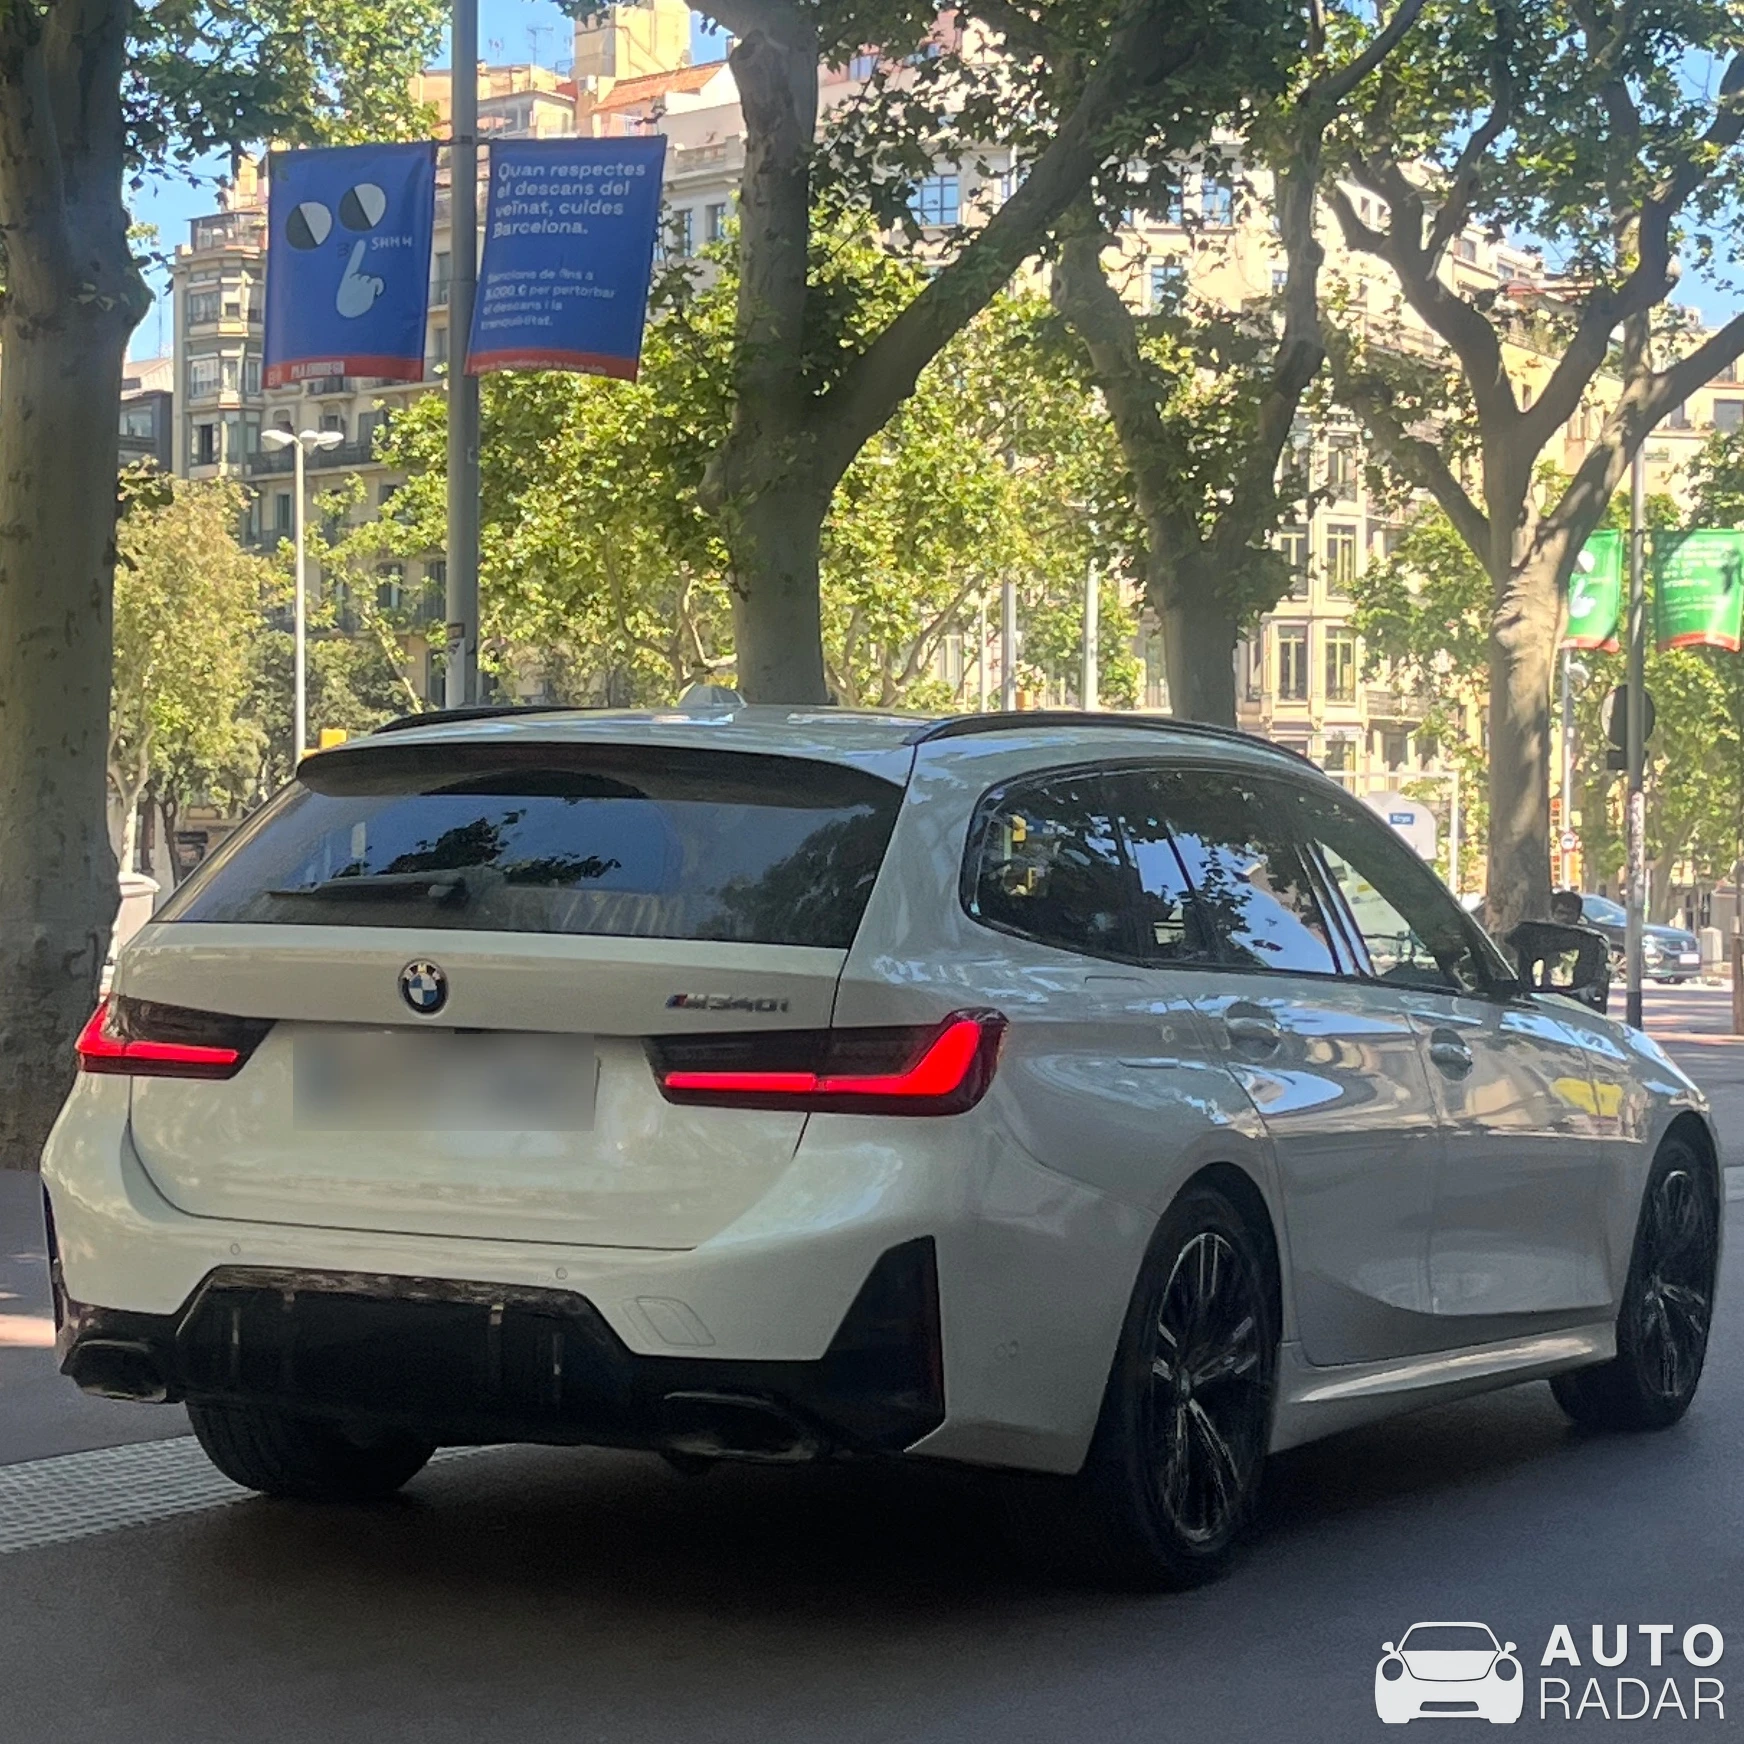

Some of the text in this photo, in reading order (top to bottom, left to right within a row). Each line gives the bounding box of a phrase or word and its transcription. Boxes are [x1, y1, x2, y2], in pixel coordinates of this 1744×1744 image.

[498, 162, 646, 182] Quan respectes
[497, 180, 631, 199] el descans del
[495, 200, 624, 217] veïnat, cuides
[492, 219, 589, 239] Barcelona.
